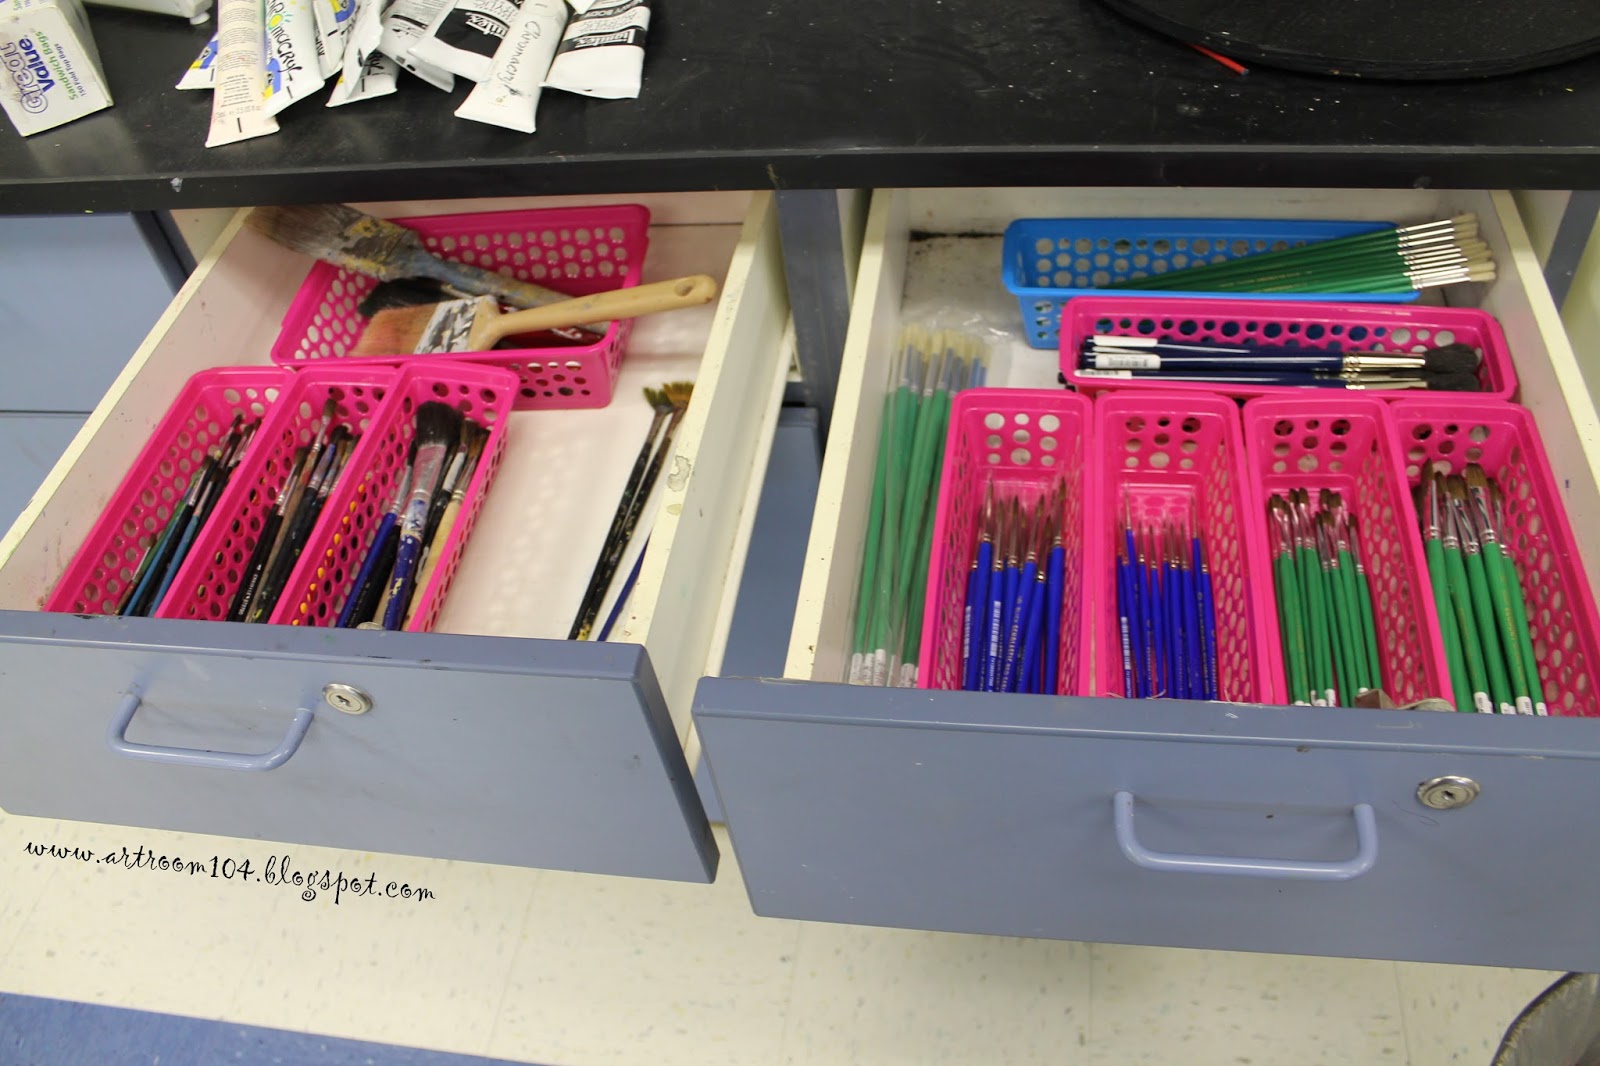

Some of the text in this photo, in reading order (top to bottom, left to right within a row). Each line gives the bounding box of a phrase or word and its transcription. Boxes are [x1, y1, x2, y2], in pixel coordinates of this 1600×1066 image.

[18, 38, 55, 93] Value
[35, 31, 78, 100] Sandwich Bags
[62, 58, 74, 71] Top
[574, 28, 636, 48] Liquitex
[0, 41, 48, 113] Great
